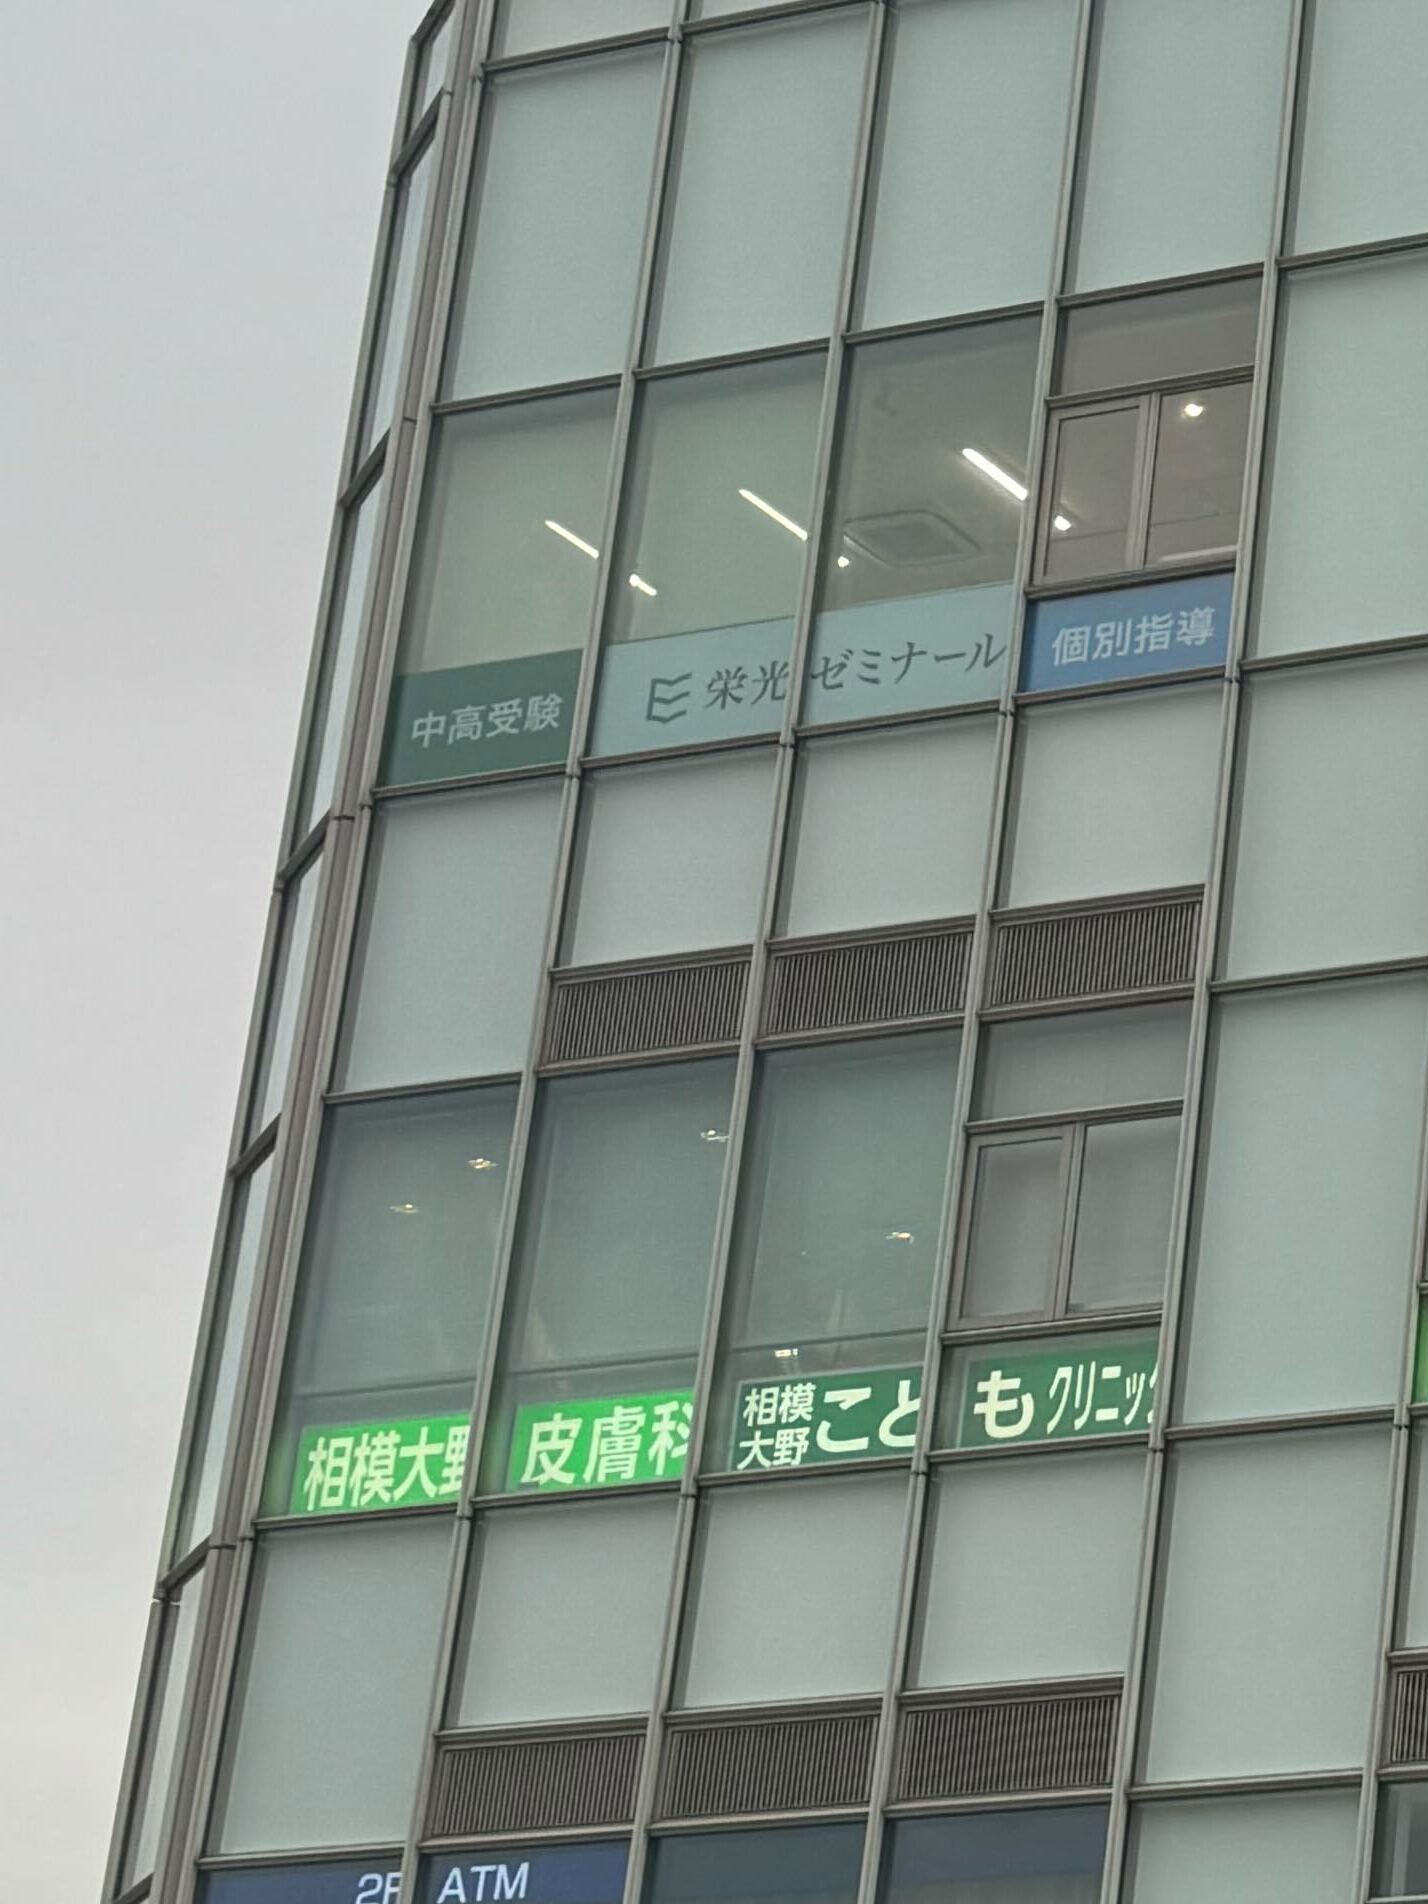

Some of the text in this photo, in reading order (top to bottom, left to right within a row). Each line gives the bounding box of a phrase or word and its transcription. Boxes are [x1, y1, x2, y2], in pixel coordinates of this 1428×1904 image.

[1052, 607, 1216, 667] 個別指導
[412, 693, 563, 749] 中高受験
[436, 1862, 530, 1904] ATM
